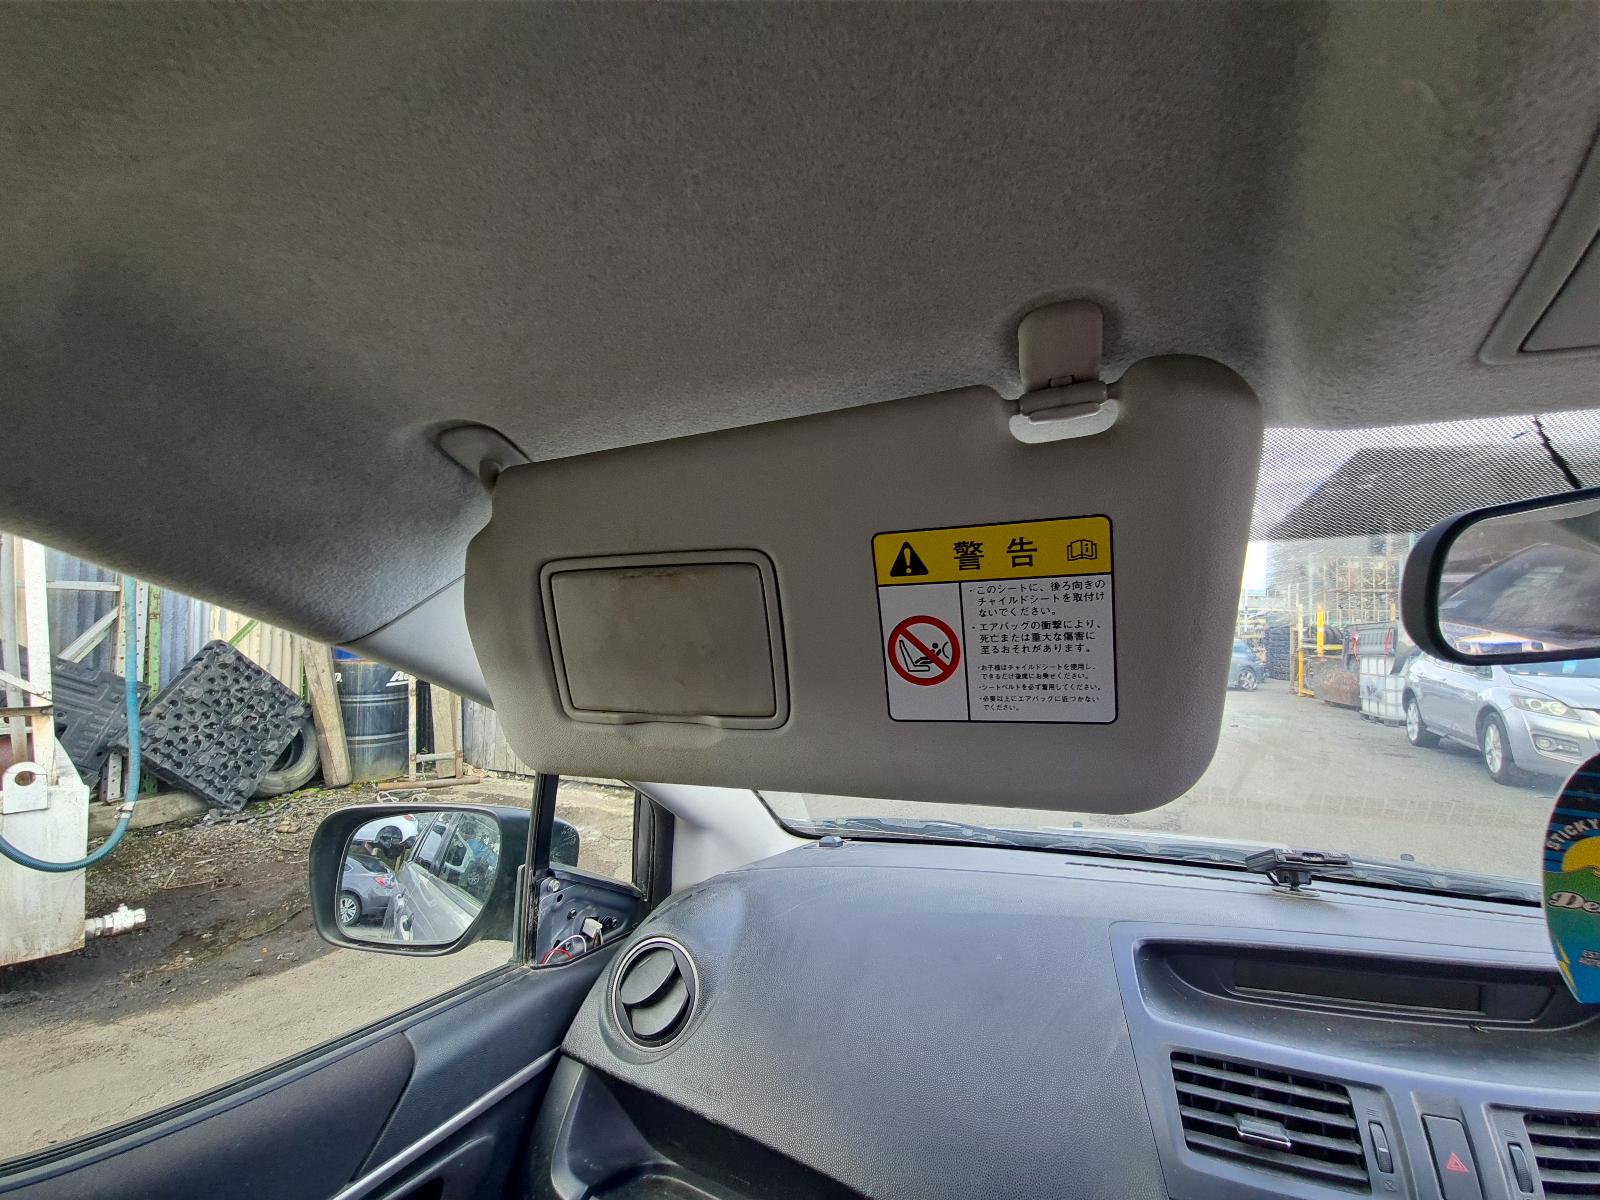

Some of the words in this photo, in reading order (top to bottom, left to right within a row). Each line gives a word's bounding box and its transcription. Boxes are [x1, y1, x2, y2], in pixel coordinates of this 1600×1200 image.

[953, 537, 1037, 571] 警告
[976, 592, 1105, 607] チャイルドシートを取付け
[978, 607, 1057, 618] ないでください。
[979, 631, 1096, 644] 死亡または重大な傷害に
[980, 643, 1091, 655] 至るおそれがあります。
